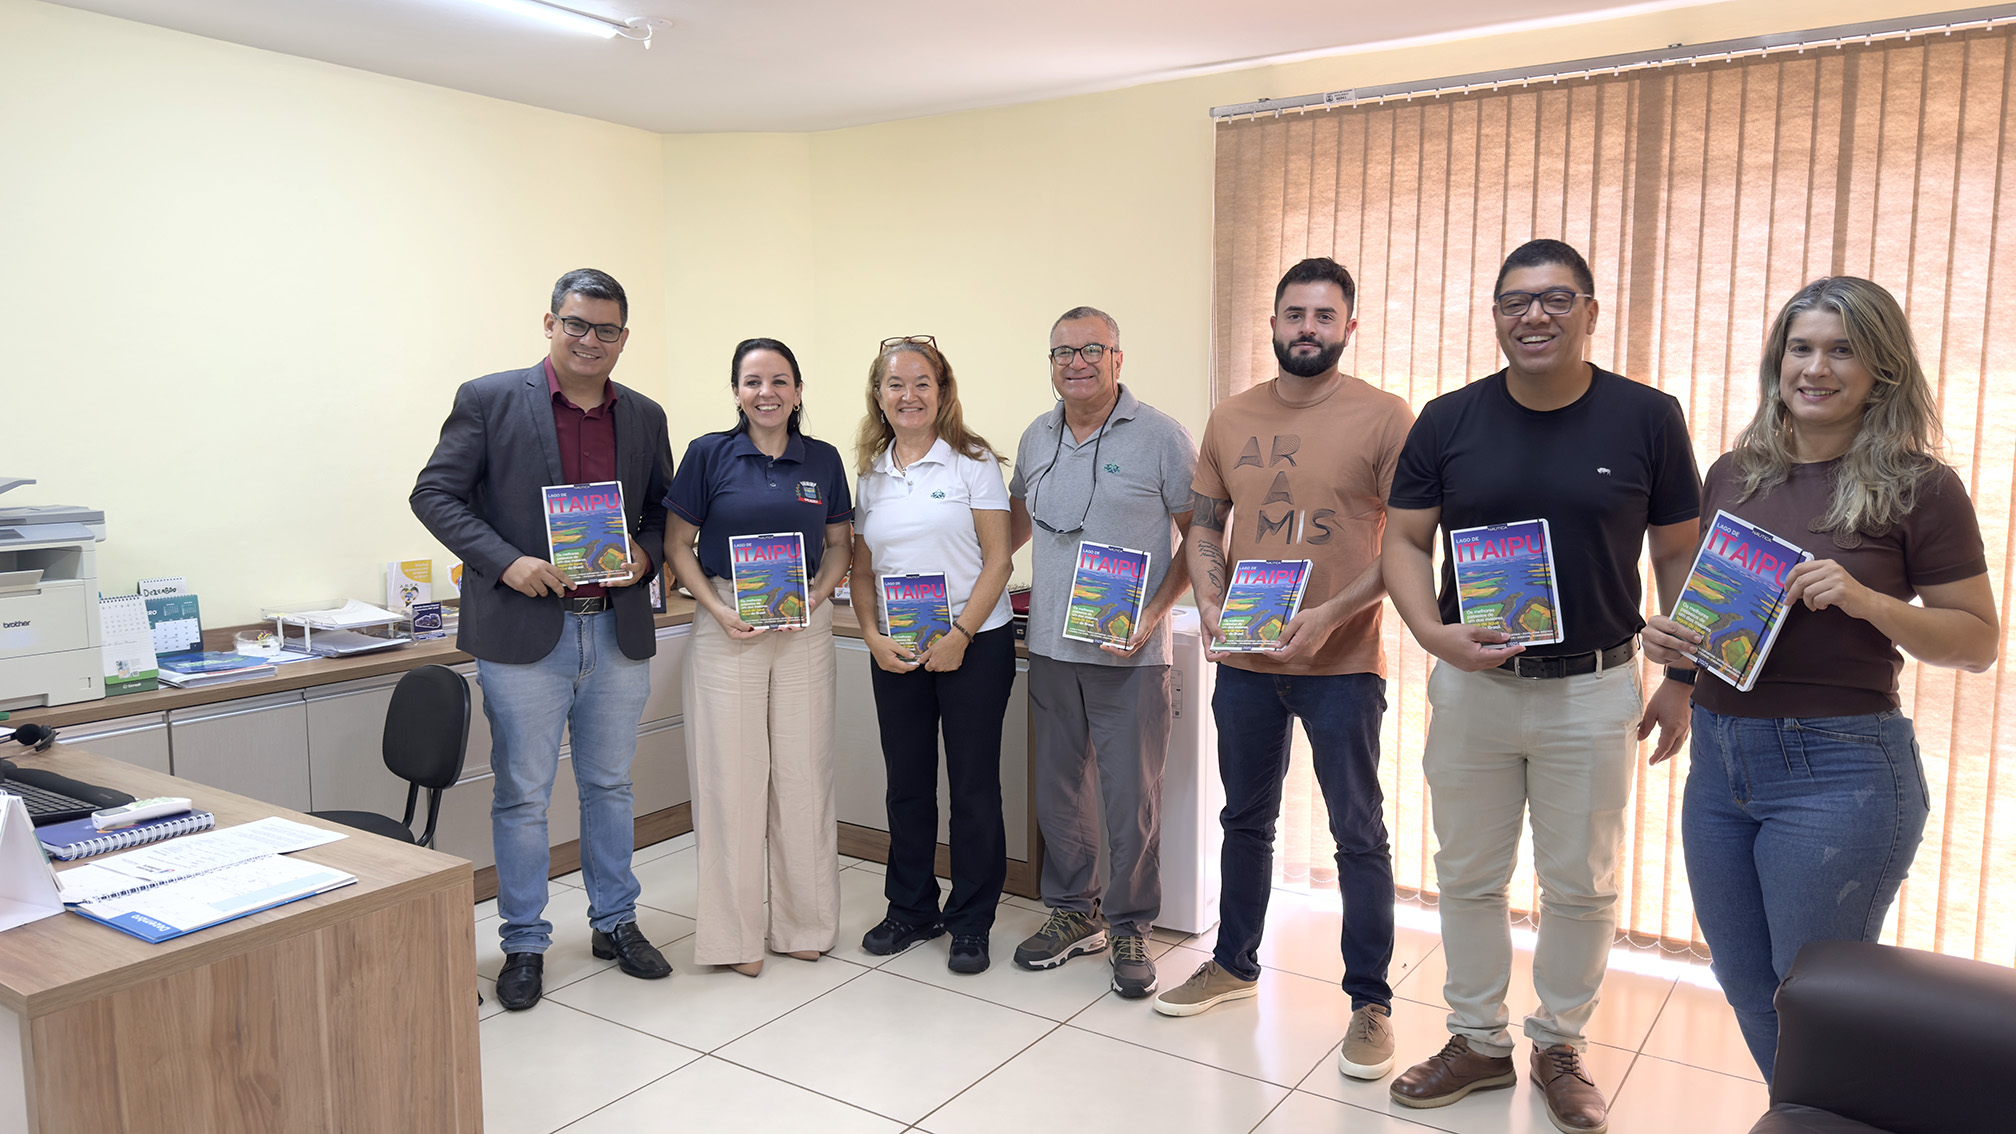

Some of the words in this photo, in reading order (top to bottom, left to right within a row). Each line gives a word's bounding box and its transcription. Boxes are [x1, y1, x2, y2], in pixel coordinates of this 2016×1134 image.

[548, 493, 619, 514] ITAIPU
[1255, 508, 1336, 546] MIS
[1716, 523, 1732, 533] LAGO
[1731, 529, 1740, 538] DE
[734, 543, 801, 562] ITAIPU
[1457, 533, 1545, 563] ITAIPU
[1080, 553, 1145, 578] ITAIPU
[1234, 569, 1304, 584] ITAIPU
[885, 583, 945, 600] ITAIPU
[3, 620, 31, 628] brother
